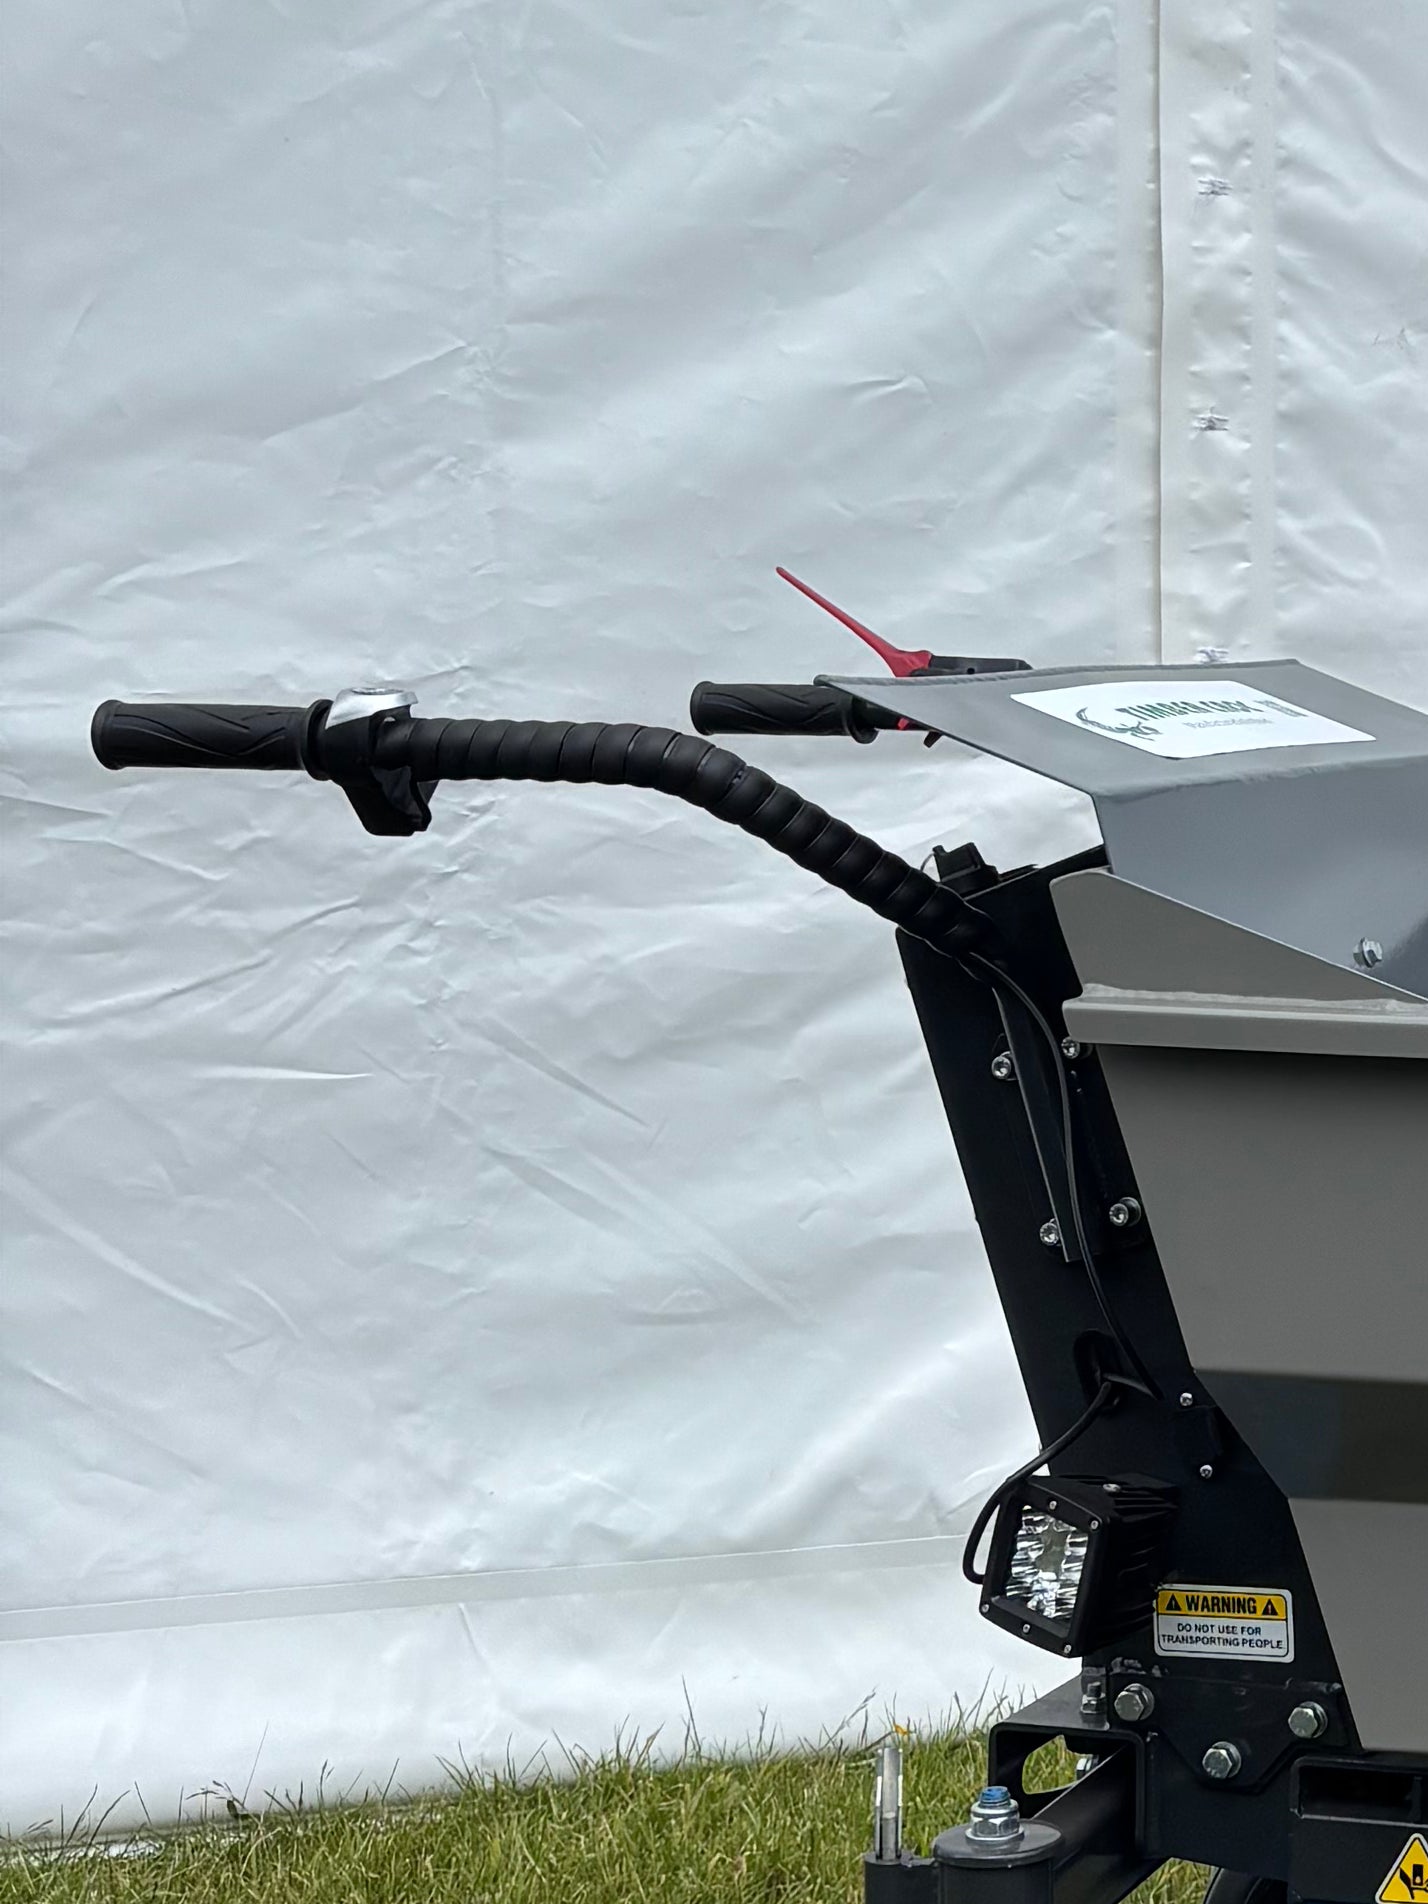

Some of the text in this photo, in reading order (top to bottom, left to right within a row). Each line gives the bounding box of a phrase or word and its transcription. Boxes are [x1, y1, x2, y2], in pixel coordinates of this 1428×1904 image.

[1185, 1594, 1257, 1614] WARNING
[1177, 1622, 1262, 1636] DO NOT USE FOR
[1161, 1634, 1240, 1647] TRANSPORTING
